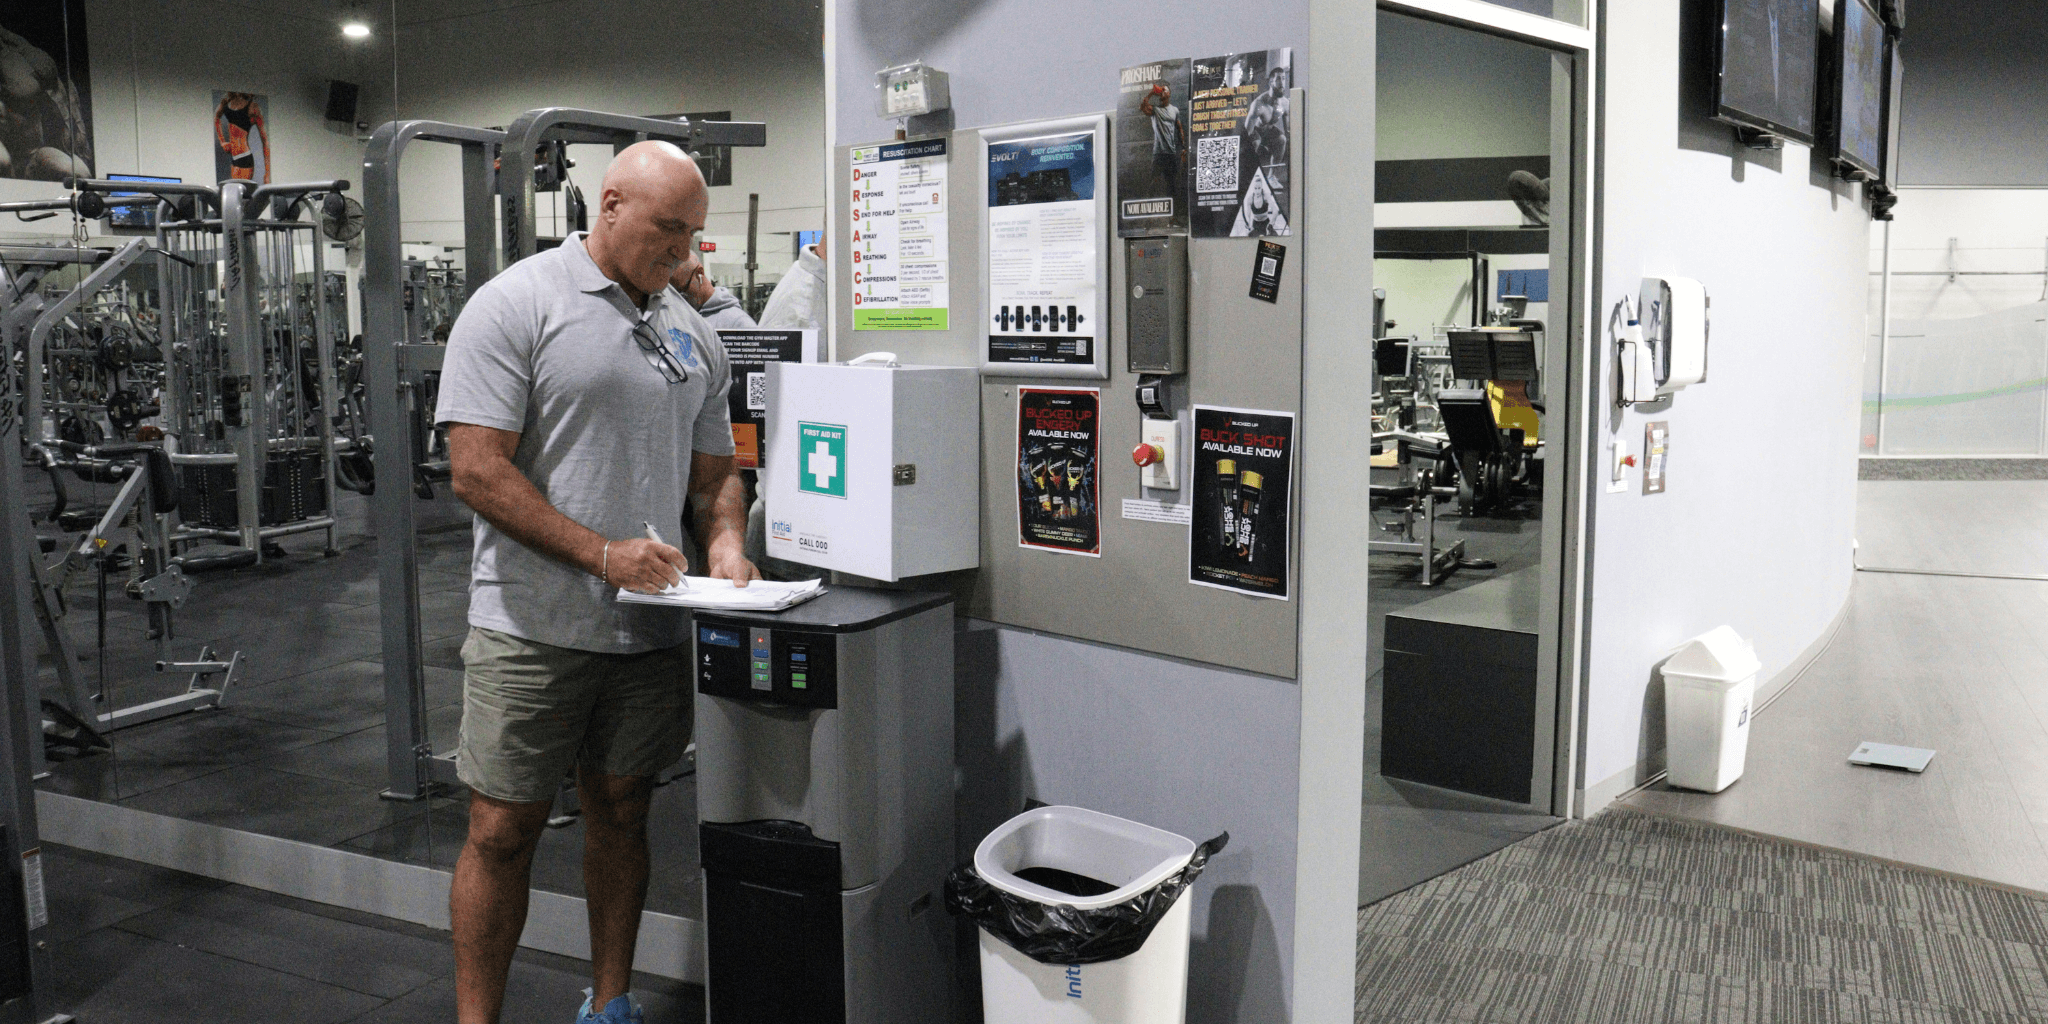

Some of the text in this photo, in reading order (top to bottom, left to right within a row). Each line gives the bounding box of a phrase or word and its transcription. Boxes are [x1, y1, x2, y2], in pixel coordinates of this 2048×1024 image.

[1121, 65, 1162, 85] PROSHAKE
[1194, 101, 1205, 110] JUST
[1192, 112, 1209, 121] CRUSH
[1228, 108, 1248, 118] FITNESS
[1192, 124, 1208, 132] GOALS
[882, 146, 923, 158] RESUSCITATION
[924, 144, 942, 153] CHART
[1026, 408, 1092, 420] BUCKED UP
[804, 428, 842, 439] FIRST AID KIT
[1028, 429, 1089, 440] AVAILABLE NOW
[1200, 428, 1286, 449] BUCK SHOT
[1202, 442, 1282, 458] AVAILABLE NOW
[799, 538, 828, 549] CALL 000
[1066, 964, 1081, 998] Initi
